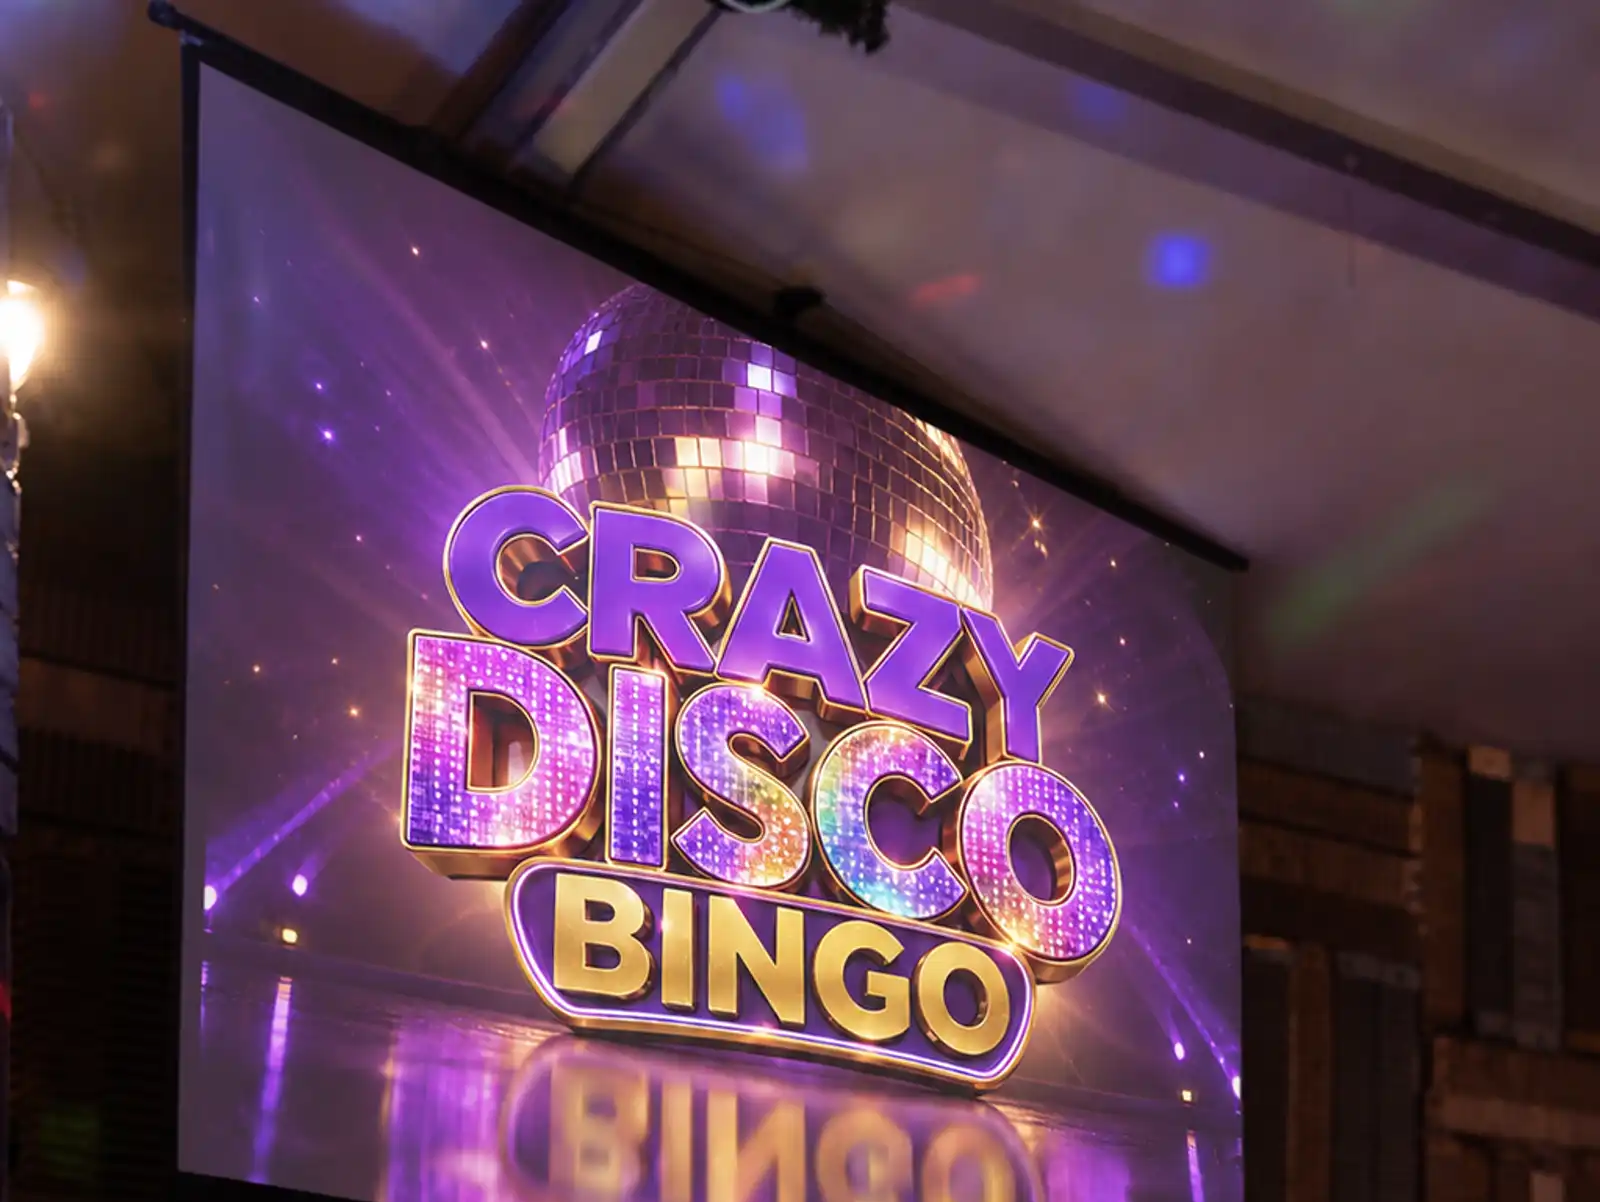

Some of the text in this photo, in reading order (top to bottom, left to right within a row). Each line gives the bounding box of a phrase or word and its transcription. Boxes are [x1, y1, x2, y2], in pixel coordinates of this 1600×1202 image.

[445, 486, 1074, 763] CRAZY
[402, 630, 1122, 966] DISCO
[552, 873, 1010, 1056] BINGO
